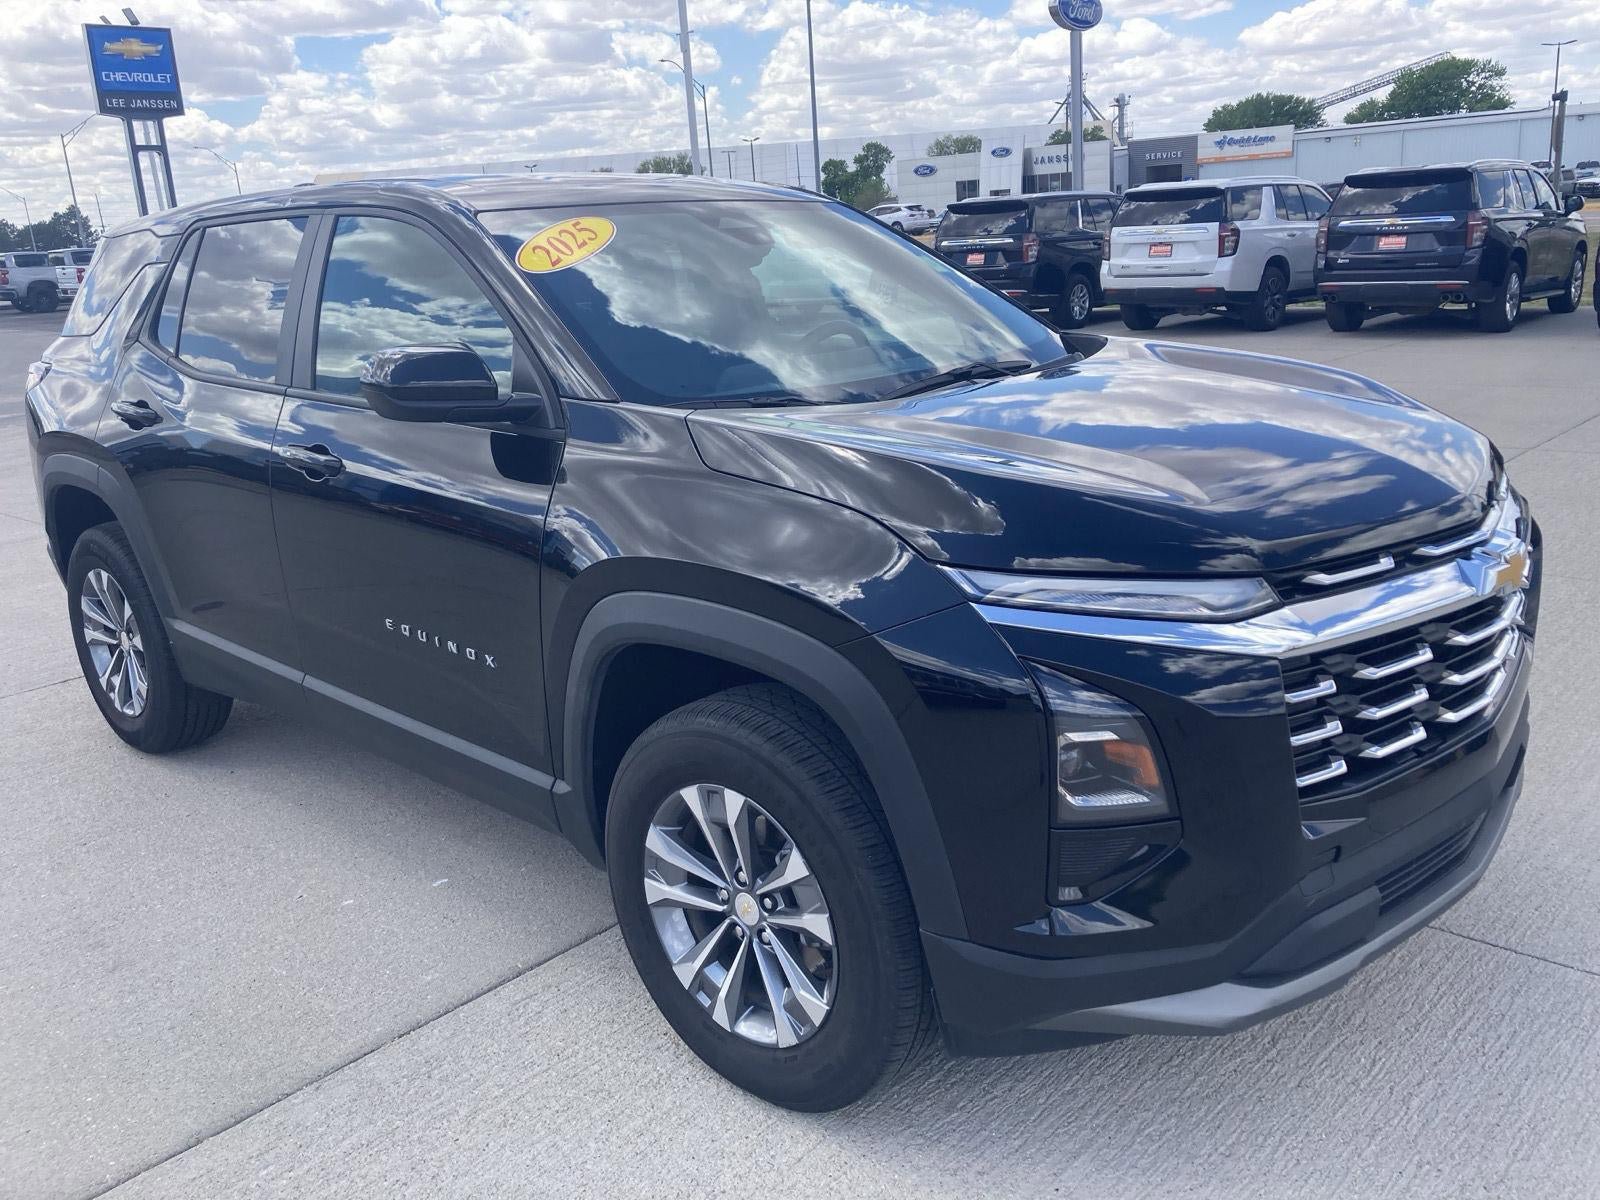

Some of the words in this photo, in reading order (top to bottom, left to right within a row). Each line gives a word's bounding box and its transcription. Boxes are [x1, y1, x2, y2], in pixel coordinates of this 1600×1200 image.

[1069, 0, 1096, 22] Ford
[101, 71, 172, 84] CHEVROLET
[106, 98, 126, 108] LEE
[130, 99, 178, 109] JANSSEN
[1145, 150, 1183, 161] SERVICE
[532, 221, 598, 267] 2025
[385, 618, 496, 668] EQUINOX
